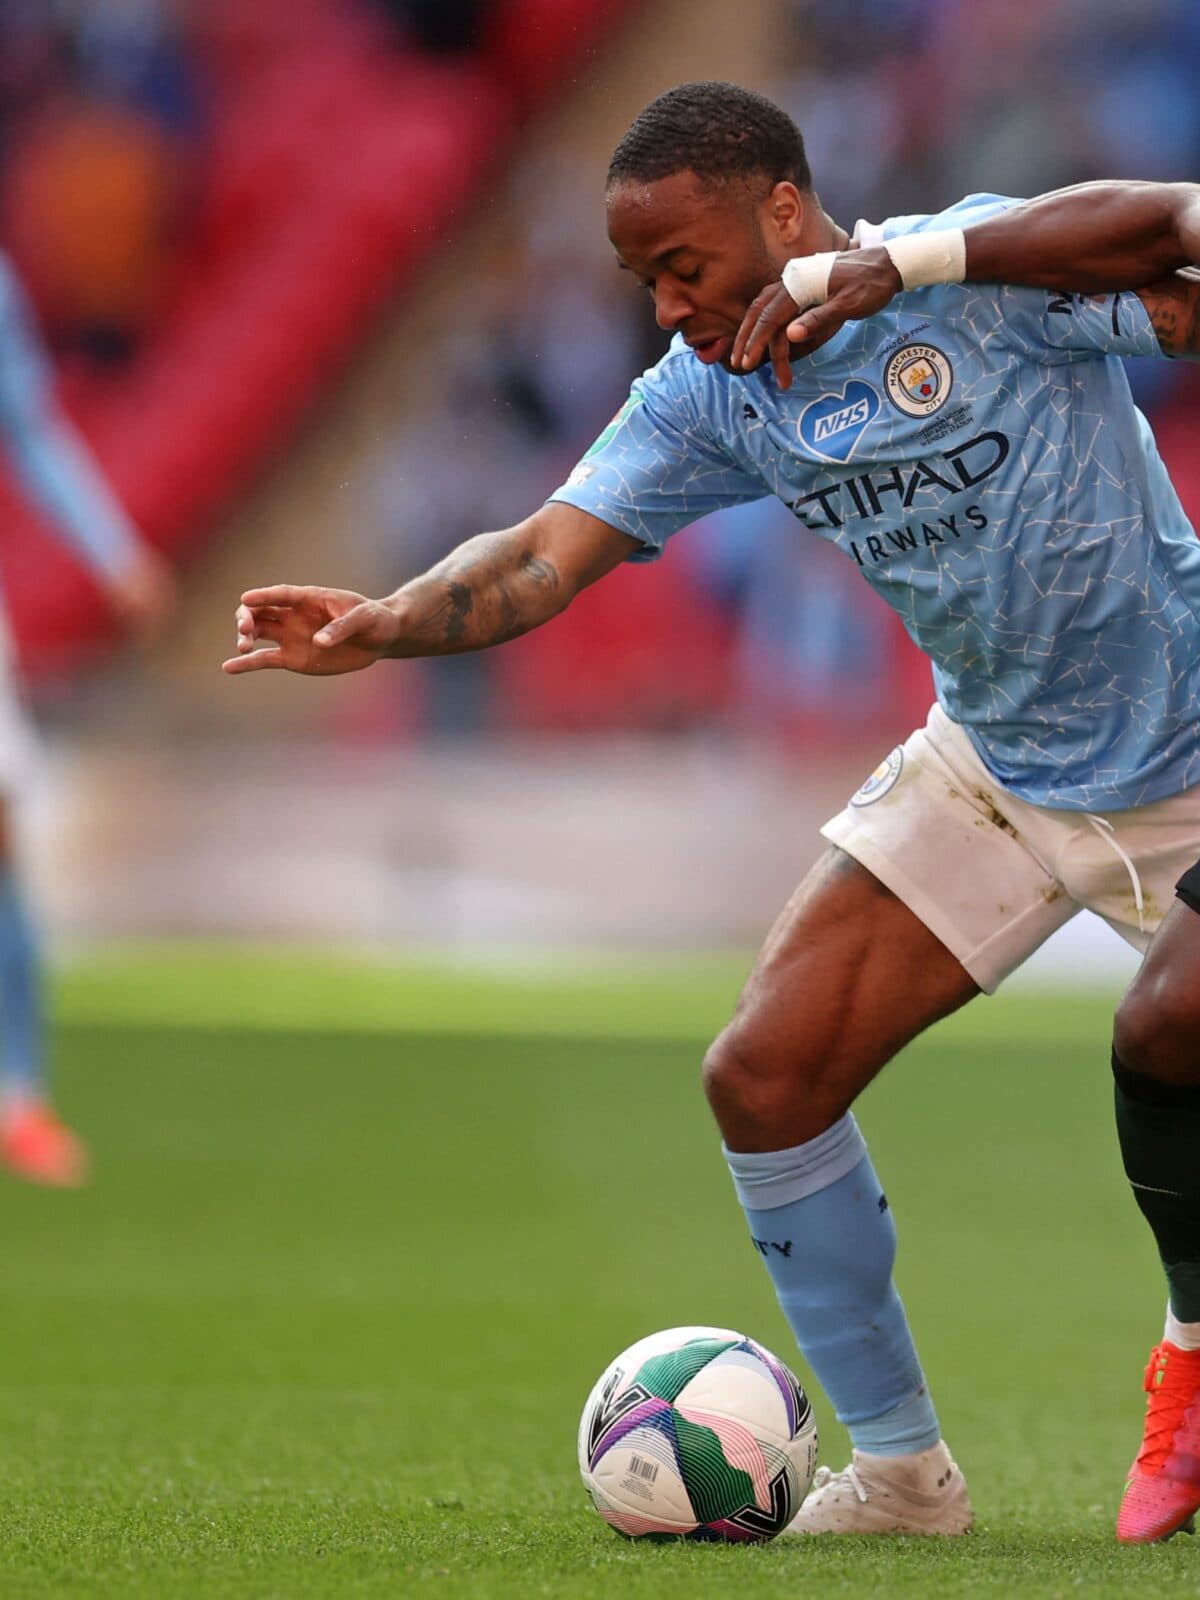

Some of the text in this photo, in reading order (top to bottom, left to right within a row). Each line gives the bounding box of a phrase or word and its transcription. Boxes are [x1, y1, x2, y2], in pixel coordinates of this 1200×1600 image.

[889, 348, 937, 386] MANCHESTER
[816, 401, 868, 437] NHS
[925, 396, 942, 412] CITY
[851, 505, 988, 566] IRWAYS
